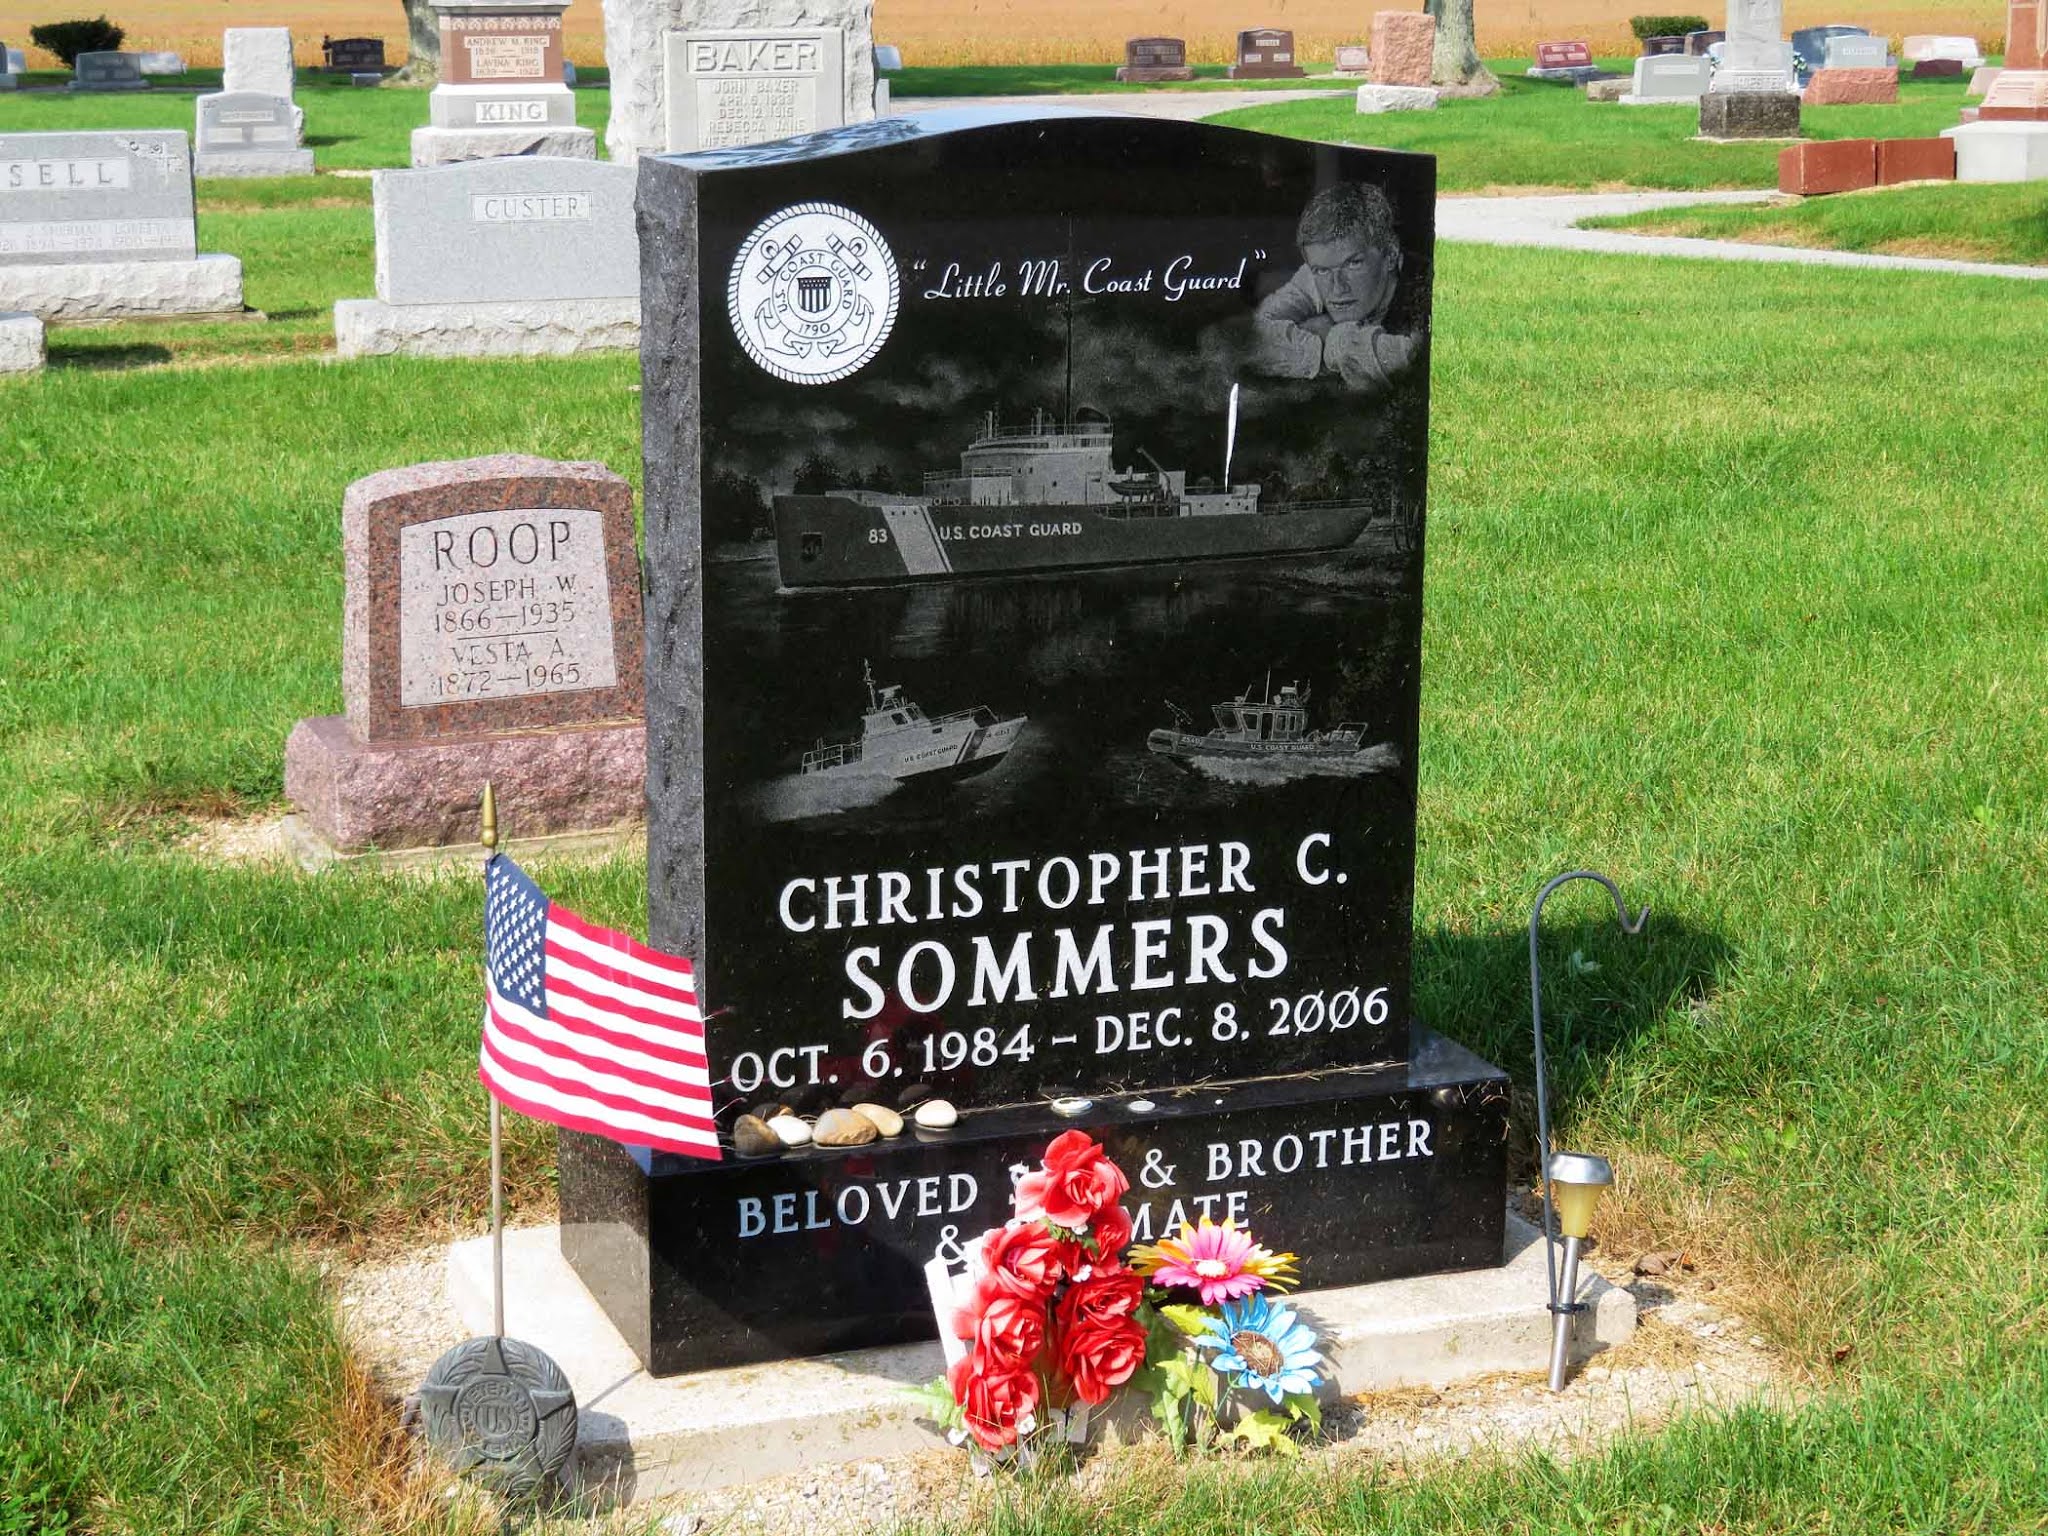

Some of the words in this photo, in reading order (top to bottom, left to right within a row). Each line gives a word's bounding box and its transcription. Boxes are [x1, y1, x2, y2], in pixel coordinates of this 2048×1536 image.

[524, 36, 547, 45] KING
[693, 41, 819, 72] BAKER
[714, 79, 748, 94] JOHN
[757, 79, 800, 93] BAKER
[481, 103, 542, 121] KING
[709, 120, 767, 134] REBECCA
[9, 162, 113, 188] SELL
[485, 197, 582, 219] CUSTER
[781, 252, 825, 282] COAST
[830, 259, 854, 310] GUARD
[1018, 259, 1071, 297] Mr.
[1083, 256, 1153, 295] Coast
[798, 322, 831, 336] 1790
[433, 520, 572, 571] ROOP
[868, 528, 889, 544] 83
[939, 525, 966, 541] U.S.
[968, 524, 1023, 540] COAST
[1029, 522, 1083, 537] GUARD
[436, 577, 536, 607] JOSEPH
[450, 639, 533, 667] VESTA
[778, 840, 1256, 933] CHRISTOPHER
[1295, 831, 1350, 886] C.
[841, 906, 1290, 1020] SOMMERS
[730, 1043, 838, 1094] OCT.
[922, 1023, 1037, 1074] 1984
[1094, 1006, 1195, 1056] DEC.
[737, 1172, 980, 1238] BELOVED
[1138, 1148, 1178, 1189] &
[1205, 1118, 1434, 1182] BROTHER
